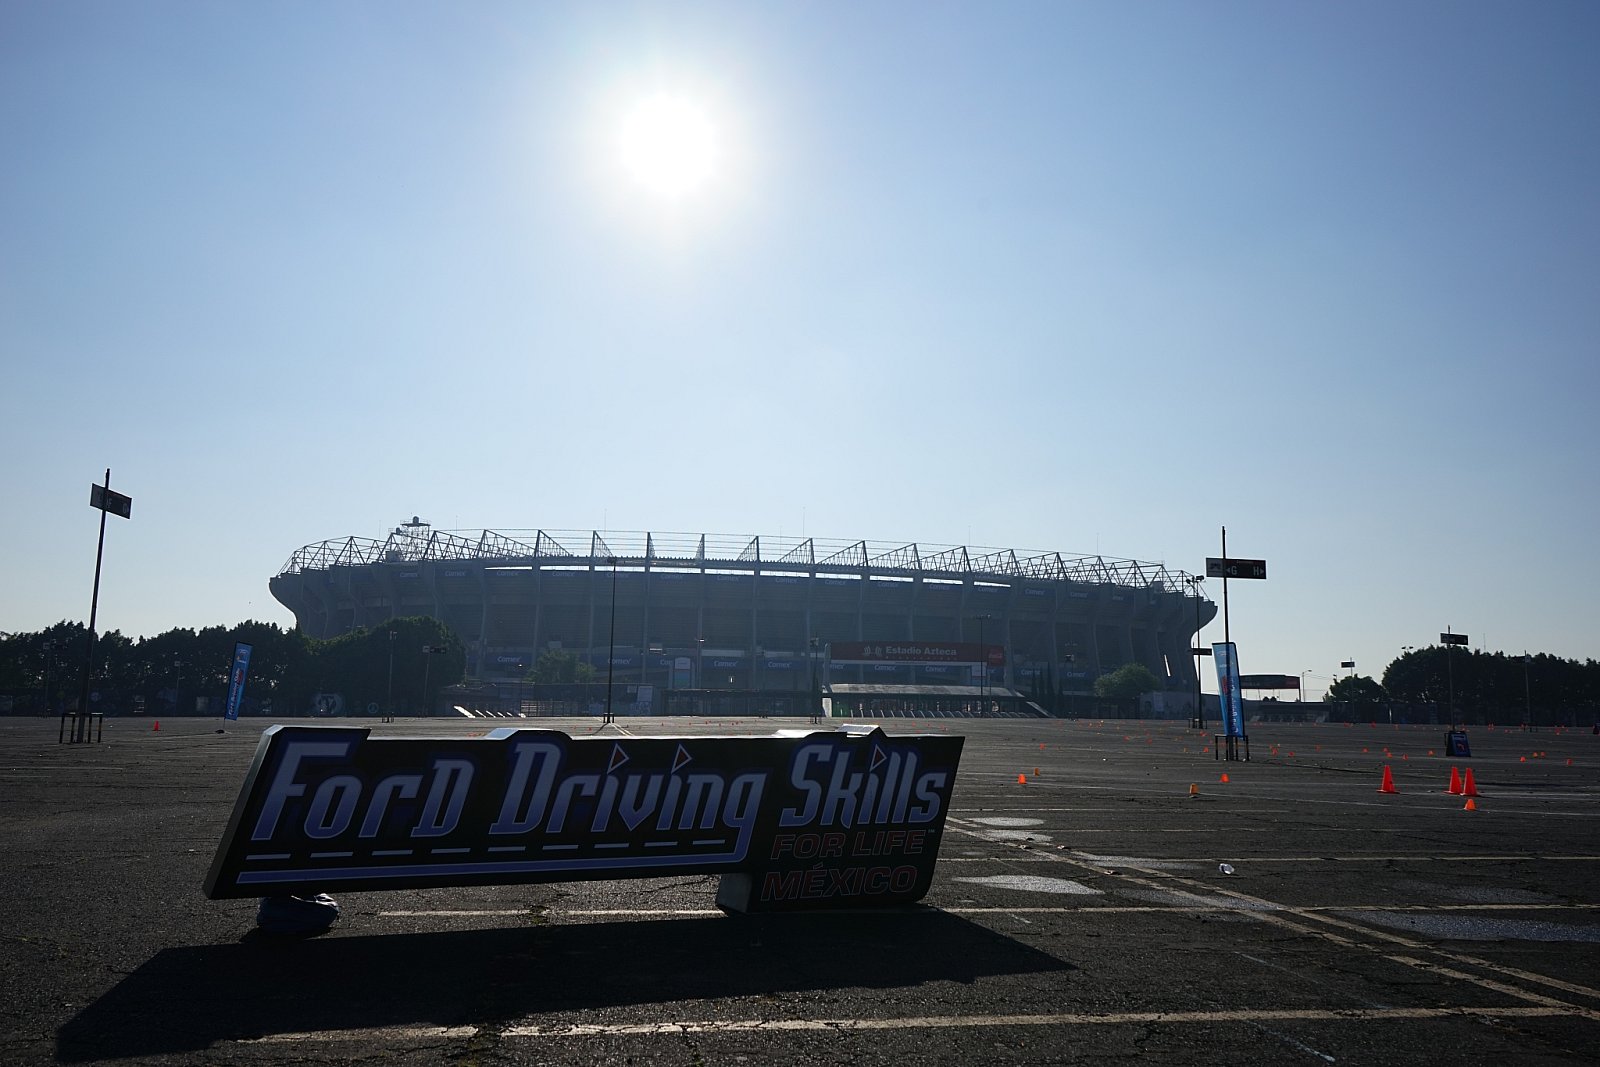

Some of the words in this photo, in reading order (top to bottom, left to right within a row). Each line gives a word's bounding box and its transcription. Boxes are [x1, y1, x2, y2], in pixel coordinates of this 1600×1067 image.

[1231, 566, 1238, 576] G
[1253, 566, 1260, 577] H
[885, 646, 922, 655] Estadio
[924, 647, 957, 656] Azteca
[488, 742, 768, 863] Driving
[778, 743, 948, 829] Skills
[770, 832, 846, 860] FOR
[851, 829, 926, 857] LIFE
[760, 861, 918, 902] MÉXICO
